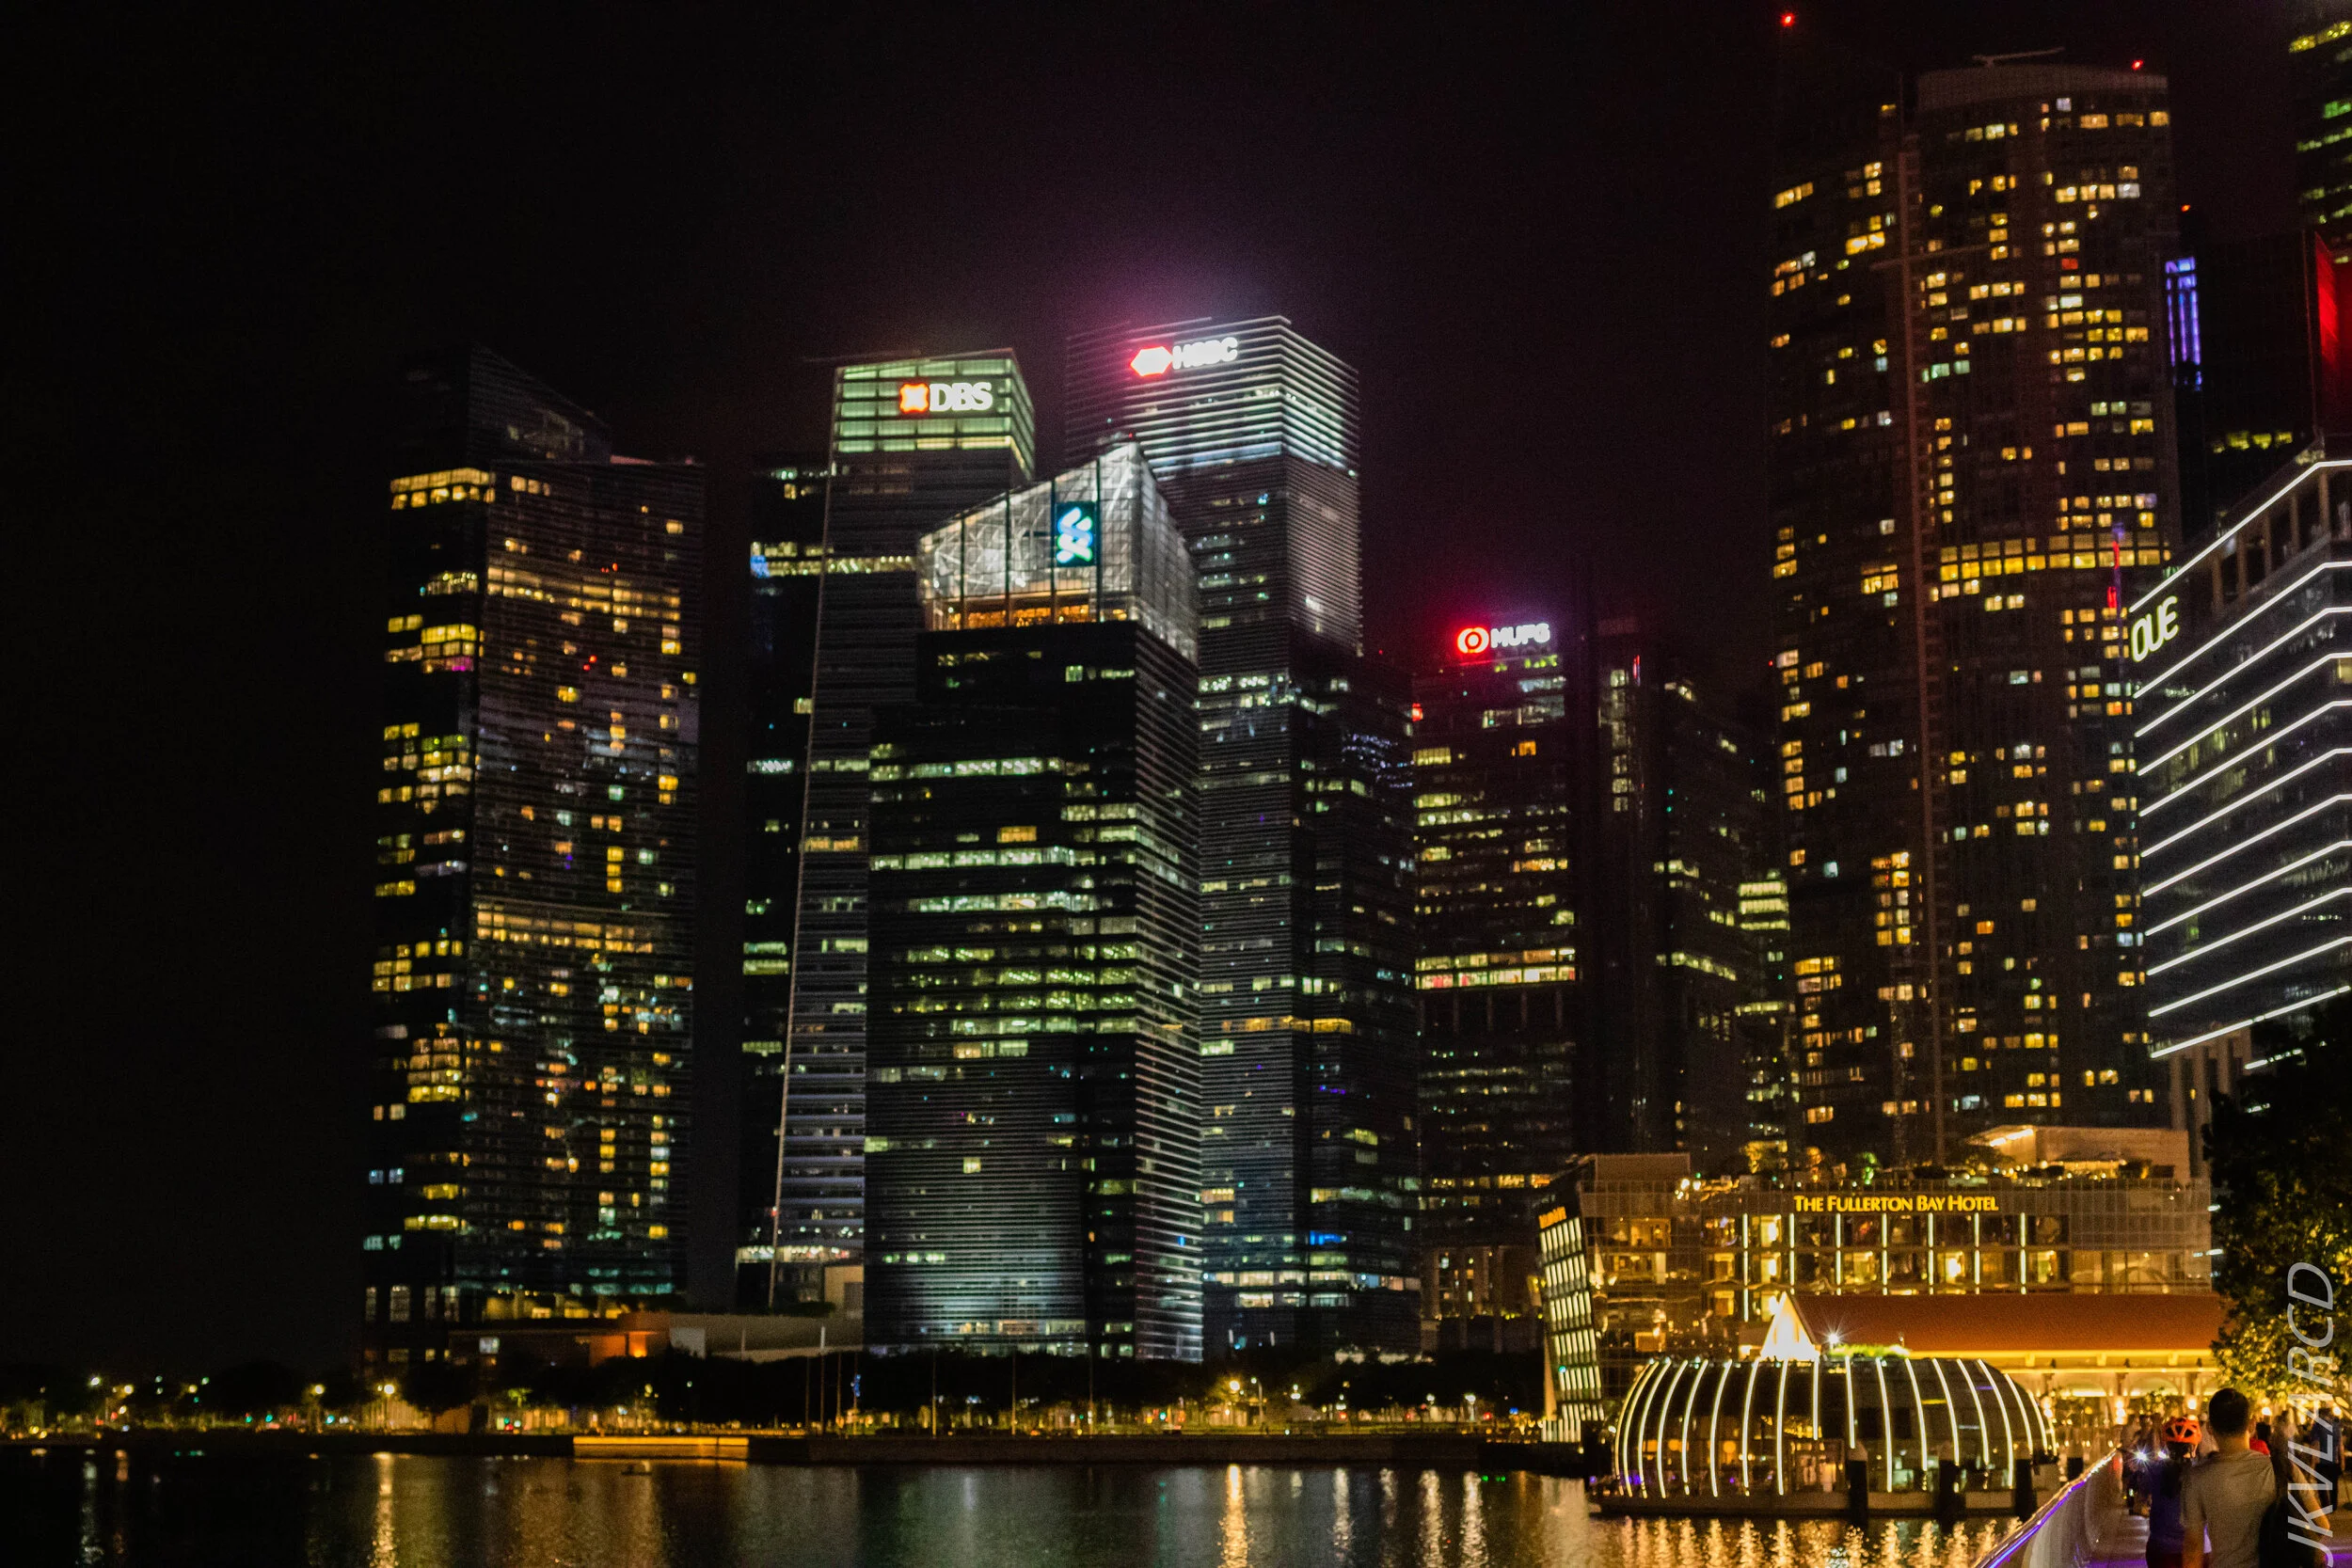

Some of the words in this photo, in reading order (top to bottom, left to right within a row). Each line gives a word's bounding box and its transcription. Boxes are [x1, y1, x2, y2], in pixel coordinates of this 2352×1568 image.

[929, 381, 993, 412] DBS
[2131, 595, 2179, 662] OUE
[1793, 1195, 1824, 1212] THE
[1826, 1195, 1914, 1212] FULLERTON
[1916, 1195, 1946, 1212] BAY
[1947, 1195, 1999, 1212] HOTEL
